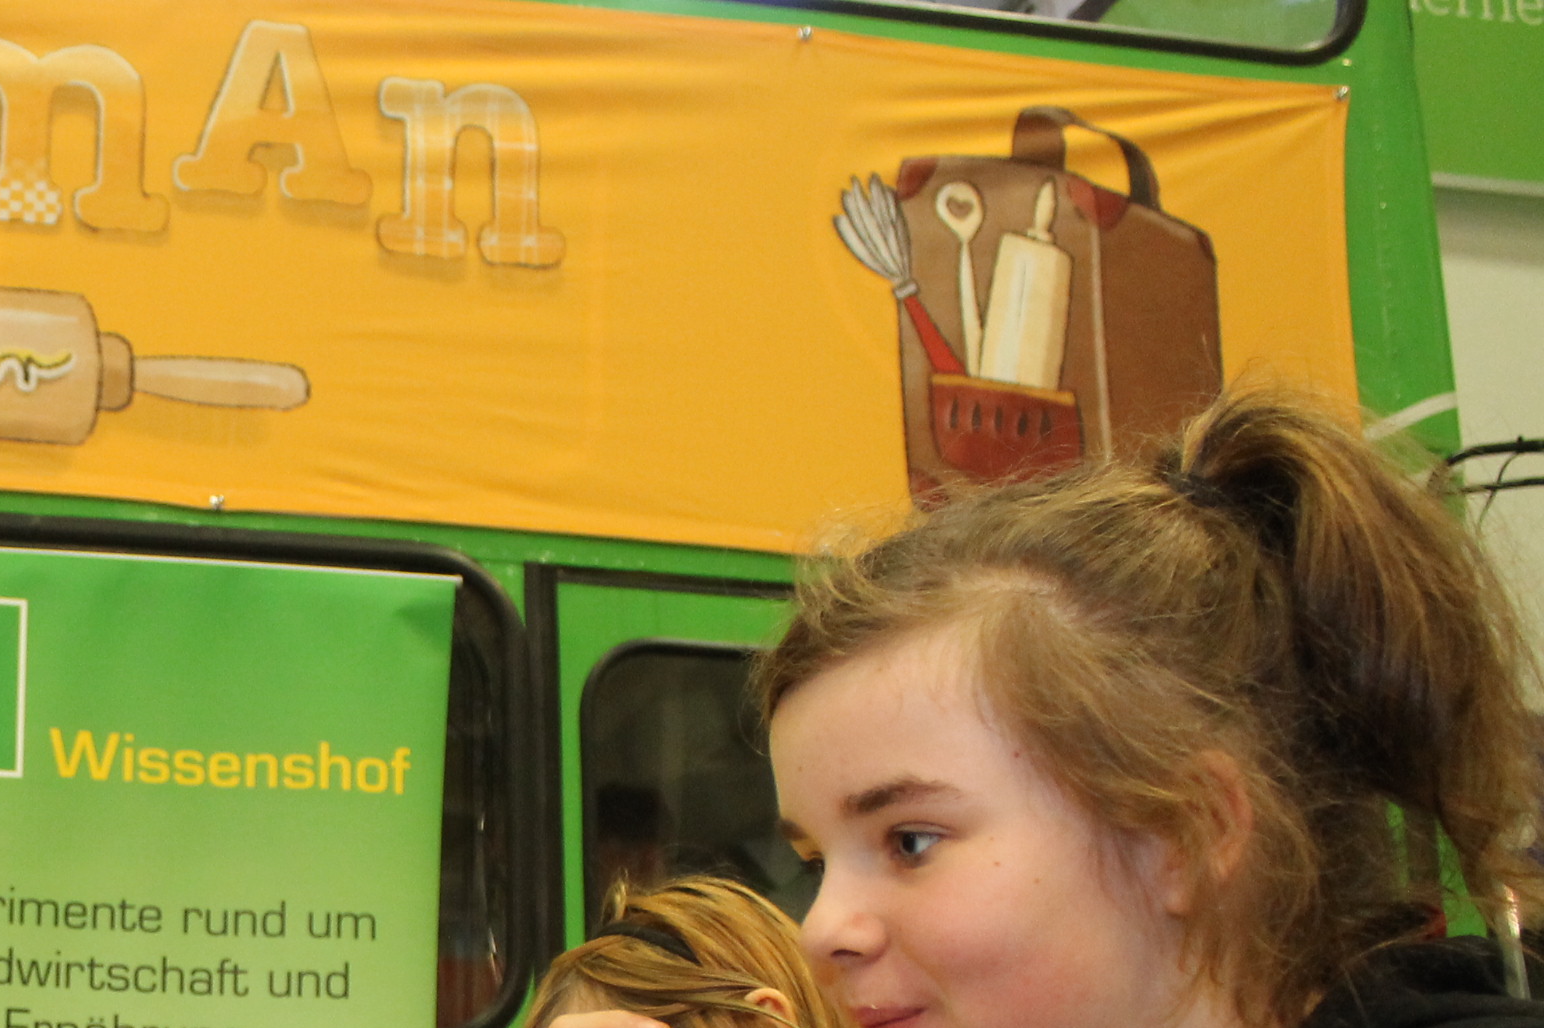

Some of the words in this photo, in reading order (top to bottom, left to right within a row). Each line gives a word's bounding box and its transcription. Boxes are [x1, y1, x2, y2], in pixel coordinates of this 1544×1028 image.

[49, 727, 412, 796] Wissenshof
[181, 899, 288, 940] rund
[306, 905, 378, 942] um
[266, 962, 351, 1000] und
